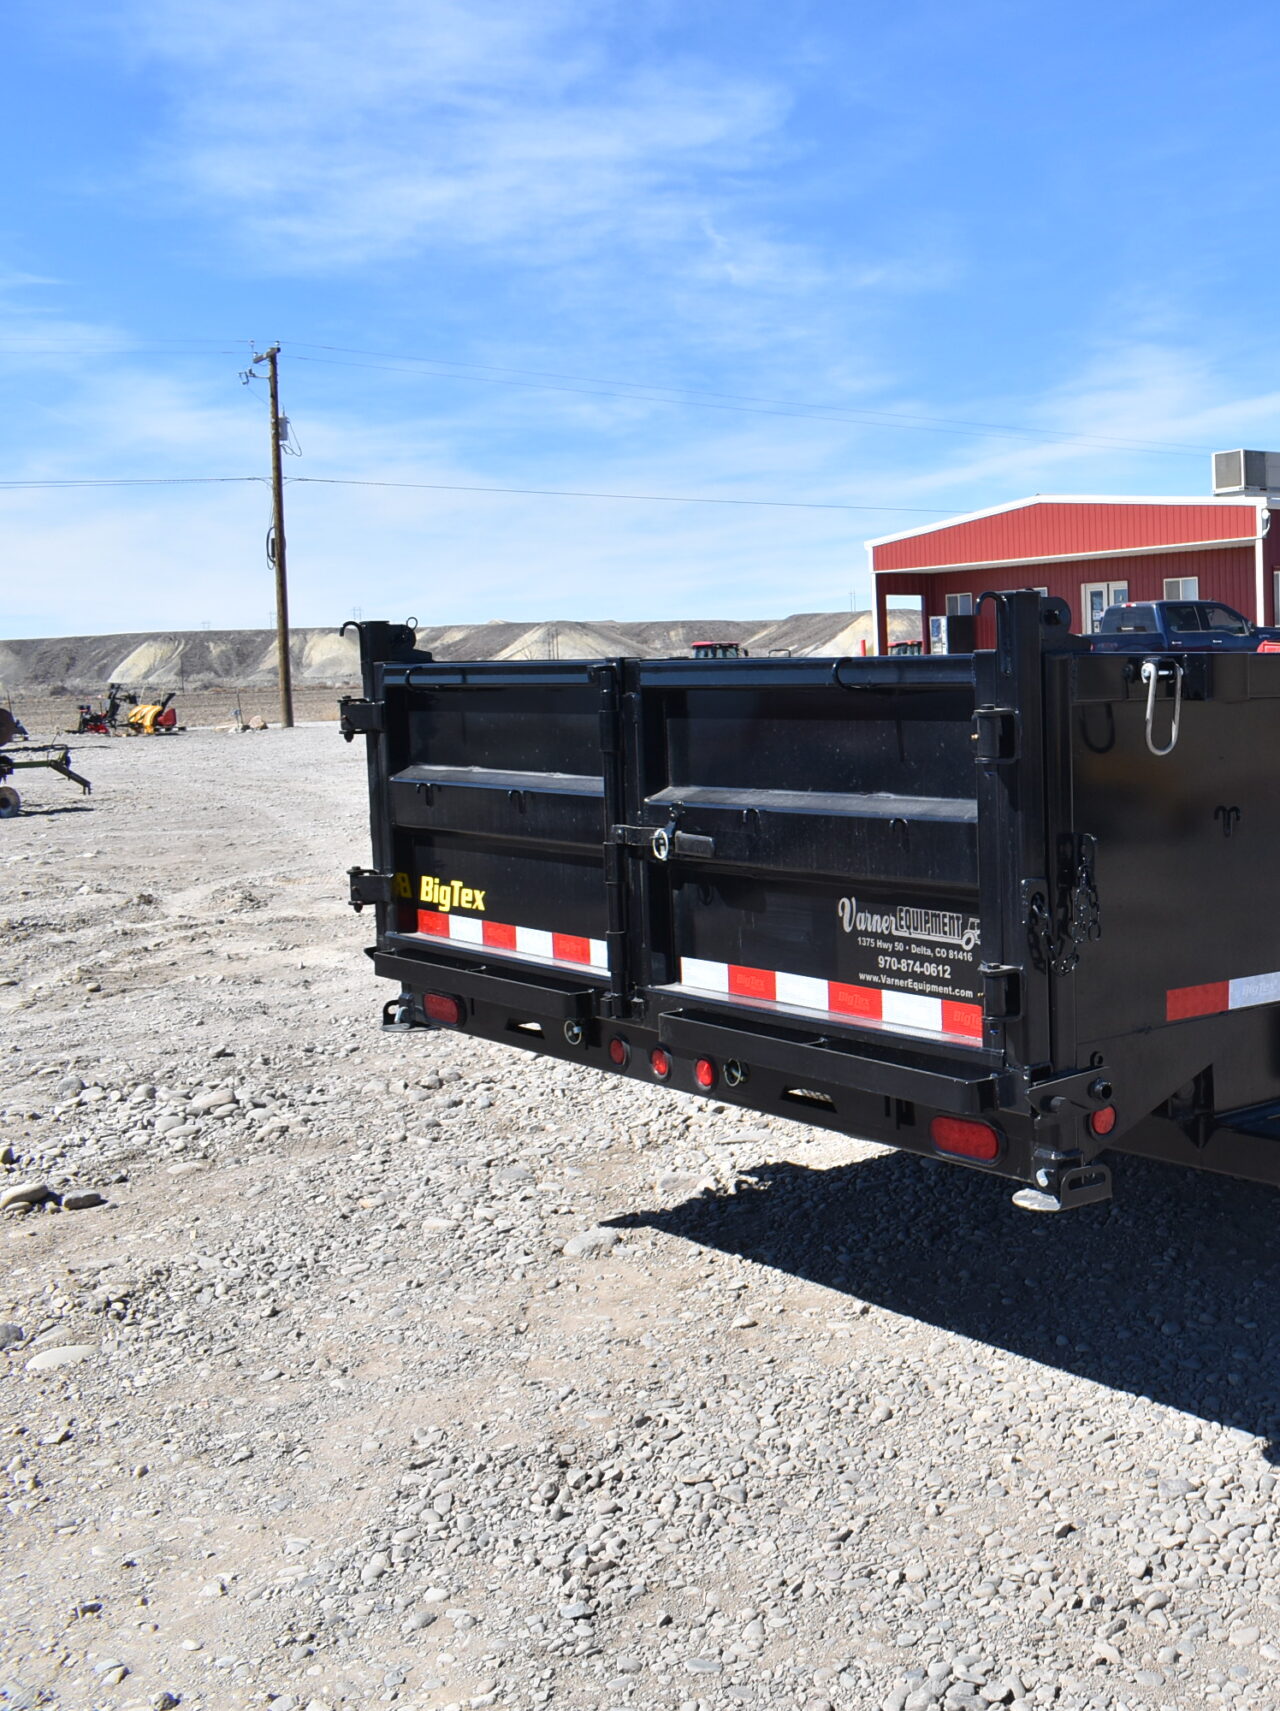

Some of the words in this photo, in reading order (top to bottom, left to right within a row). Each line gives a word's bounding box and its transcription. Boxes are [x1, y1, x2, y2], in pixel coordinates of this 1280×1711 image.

[420, 875, 486, 912] BigTex
[838, 897, 900, 936] Varner
[897, 906, 963, 940] EQUIPMENT
[857, 936, 875, 948] 1375
[876, 939, 893, 952] Hwy
[894, 941, 904, 952] 50
[911, 944, 934, 958] Delta,
[935, 947, 947, 959] CO
[948, 949, 973, 962] 81416
[877, 955, 952, 979] 970-874-0612
[858, 971, 974, 999] www.VarnerEquipment.com
